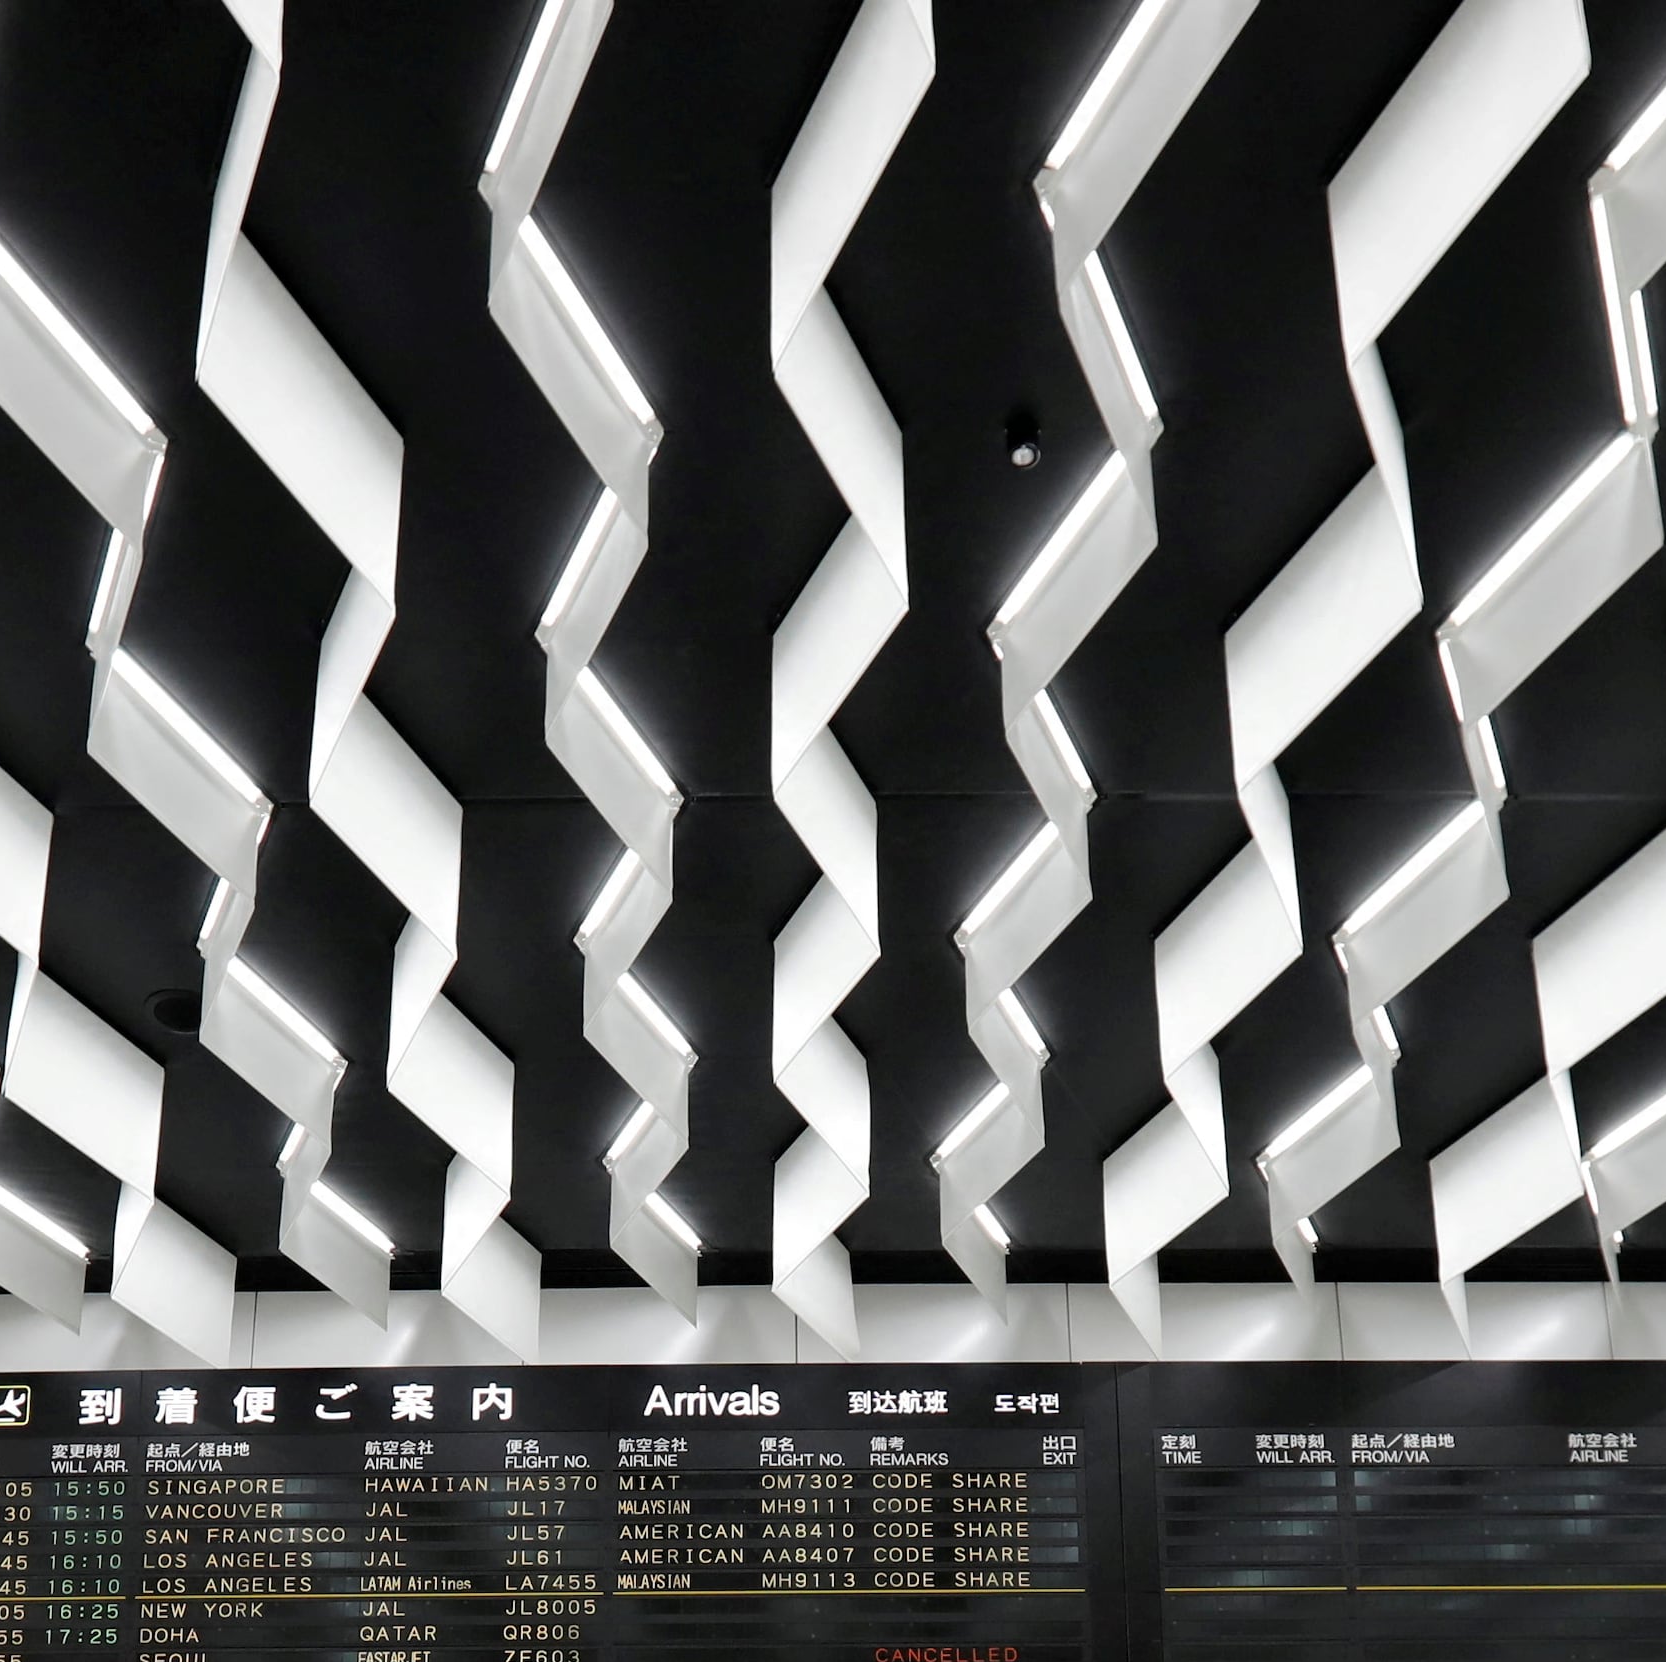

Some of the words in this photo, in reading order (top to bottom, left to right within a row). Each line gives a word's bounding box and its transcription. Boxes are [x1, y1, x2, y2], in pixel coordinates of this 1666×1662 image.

[644, 1384, 780, 1416] Arrivals
[848, 1390, 948, 1414] 到达航班
[1568, 1433, 1637, 1448] 航空会社
[1162, 1451, 1201, 1464] TIME
[1352, 1450, 1429, 1463] FROM/VIA
[1570, 1450, 1628, 1462] AIRLINE
[55, 1481, 124, 1496] 15:50
[148, 1479, 284, 1495] SINGAPORE
[366, 1477, 487, 1492] HAWAIIAN
[507, 1476, 596, 1491] HA5370
[620, 1476, 679, 1490] MIAT
[762, 1474, 852, 1489] OM7302
[873, 1474, 932, 1488] CODE
[953, 1473, 1027, 1488] SHARE
[48, 1604, 118, 1619] 16:25
[142, 1603, 186, 1618] NEW
[204, 1603, 262, 1617] YORK
[363, 1602, 405, 1616] JAL
[506, 1600, 595, 1615] JL8005
